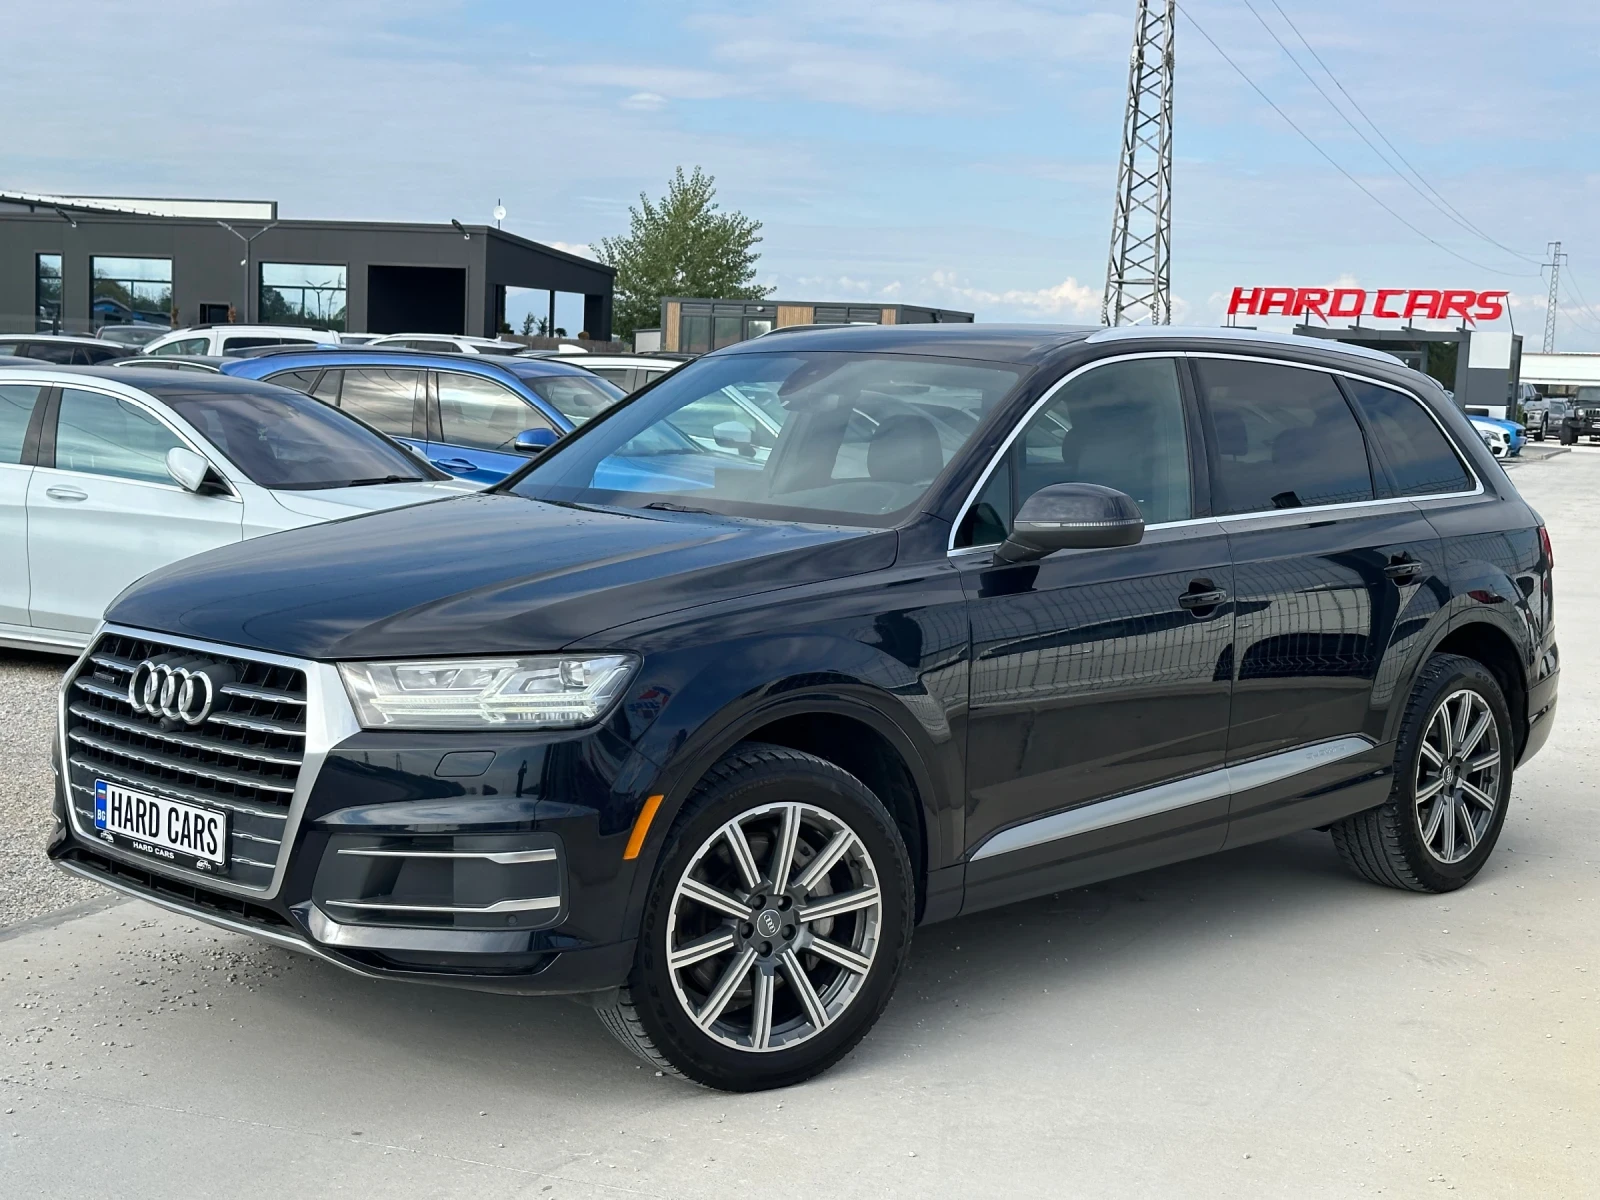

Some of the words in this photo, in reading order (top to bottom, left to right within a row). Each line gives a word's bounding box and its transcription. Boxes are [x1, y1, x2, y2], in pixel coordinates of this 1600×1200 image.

[1227, 287, 1366, 326] HARD
[1373, 290, 1510, 328] CARS
[97, 809, 106, 821] BG
[111, 791, 160, 838] HARD
[167, 807, 218, 855] CARS
[133, 841, 153, 853] HARD
[154, 849, 174, 859] CARS
